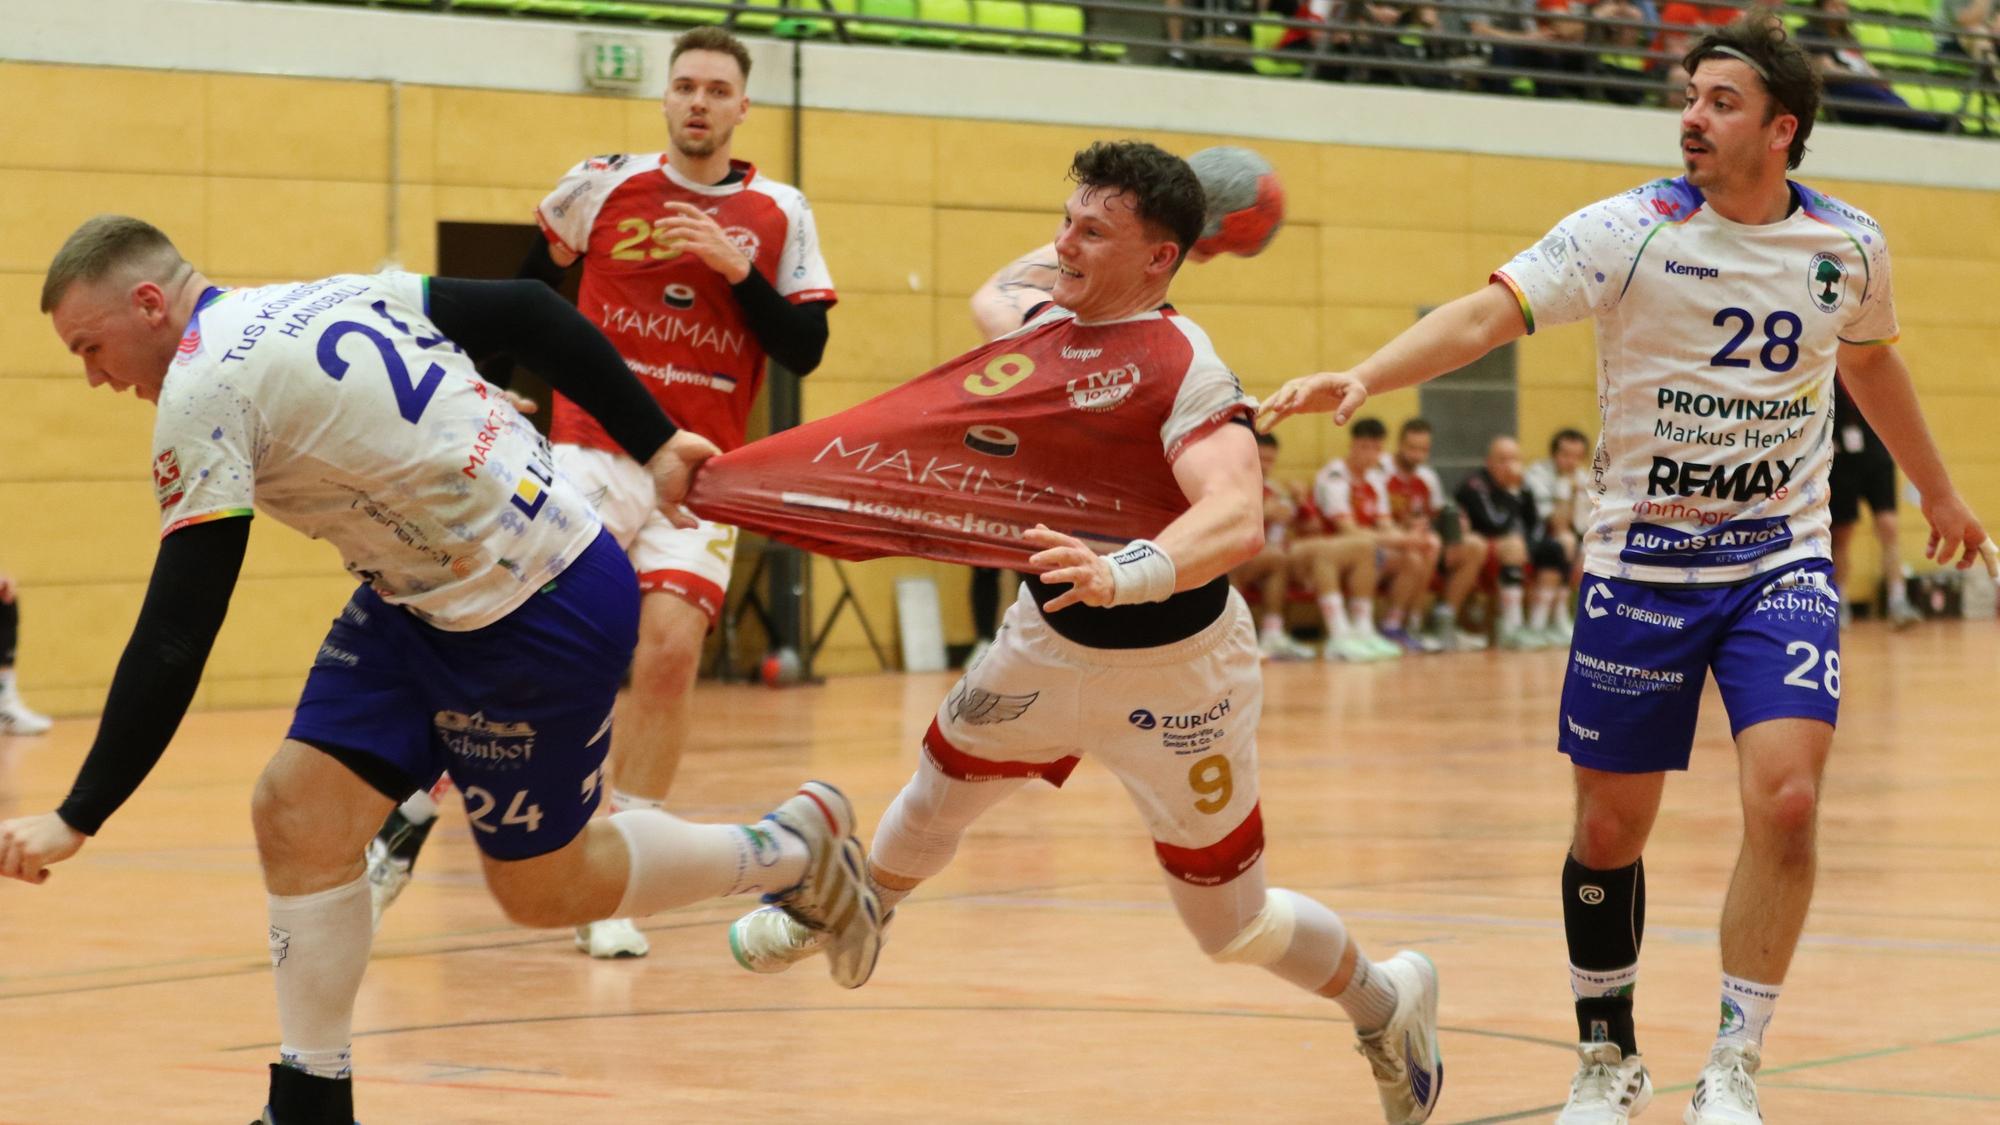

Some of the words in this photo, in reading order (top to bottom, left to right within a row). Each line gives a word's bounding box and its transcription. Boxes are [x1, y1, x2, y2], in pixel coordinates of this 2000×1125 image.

[1665, 260, 1719, 279] Kempa
[280, 285, 370, 338] HANDBALL
[602, 303, 745, 356] MAKIMAN
[221, 324, 266, 364] TuS
[1061, 346, 1103, 361] Kempa
[1710, 307, 1803, 373] 28
[963, 353, 1035, 396] 9
[1088, 368, 1127, 389] TVP
[1657, 387, 1816, 421] PROVINZIAL
[1654, 418, 1736, 447] Markus
[1647, 456, 1806, 502] REMAX
[1632, 524, 1786, 551] AUTOSTATION
[1616, 603, 1686, 630] CYBERDYNE
[1783, 640, 1841, 700] 28
[1161, 699, 1231, 730] ZURICH
[1189, 753, 1233, 815] 9
[464, 785, 544, 834] 24
